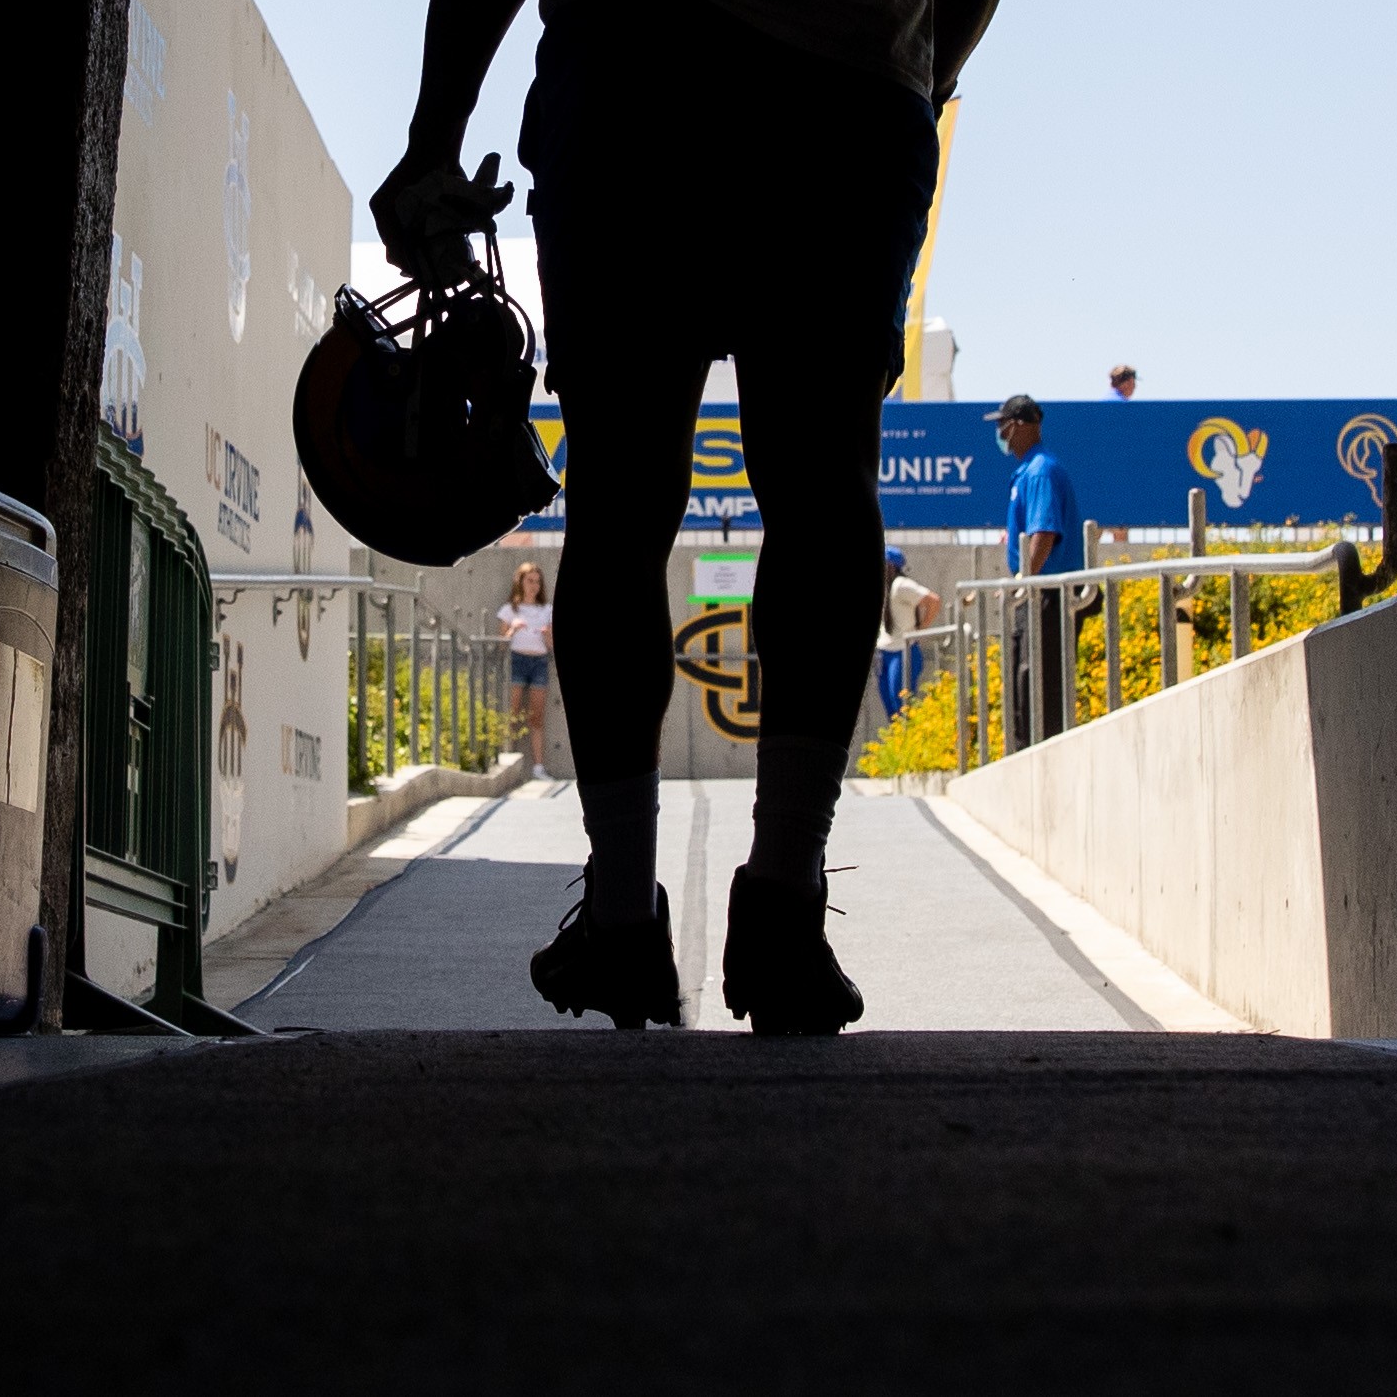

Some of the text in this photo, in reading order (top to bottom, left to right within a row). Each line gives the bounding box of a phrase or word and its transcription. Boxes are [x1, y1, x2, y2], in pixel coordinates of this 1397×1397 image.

[205, 421, 260, 523] UC IRVINE
[878, 456, 973, 482] UNIFY
[685, 496, 760, 518] AMP
